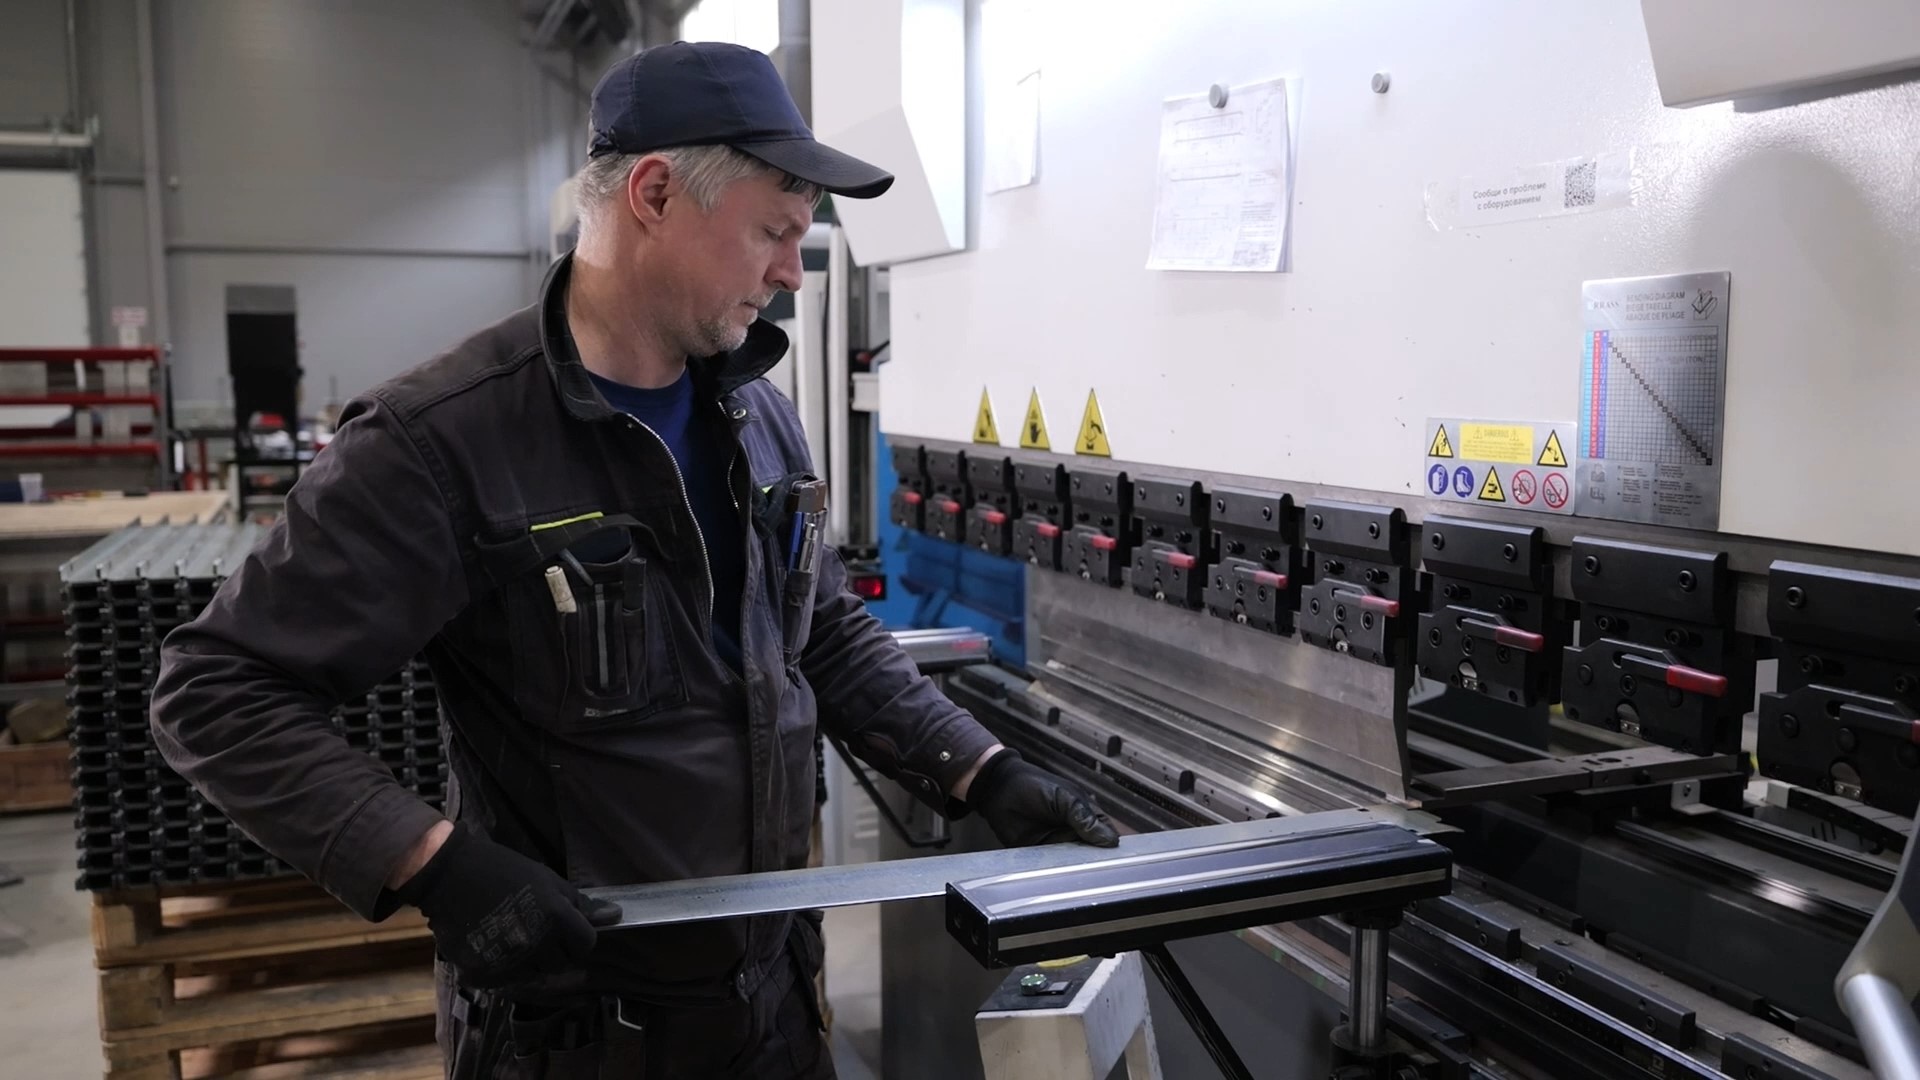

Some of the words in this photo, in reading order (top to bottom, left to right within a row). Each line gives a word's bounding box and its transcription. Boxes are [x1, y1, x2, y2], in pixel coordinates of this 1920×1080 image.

[1472, 188, 1501, 200] Сообщи
[1509, 182, 1547, 195] проблеме
[1483, 195, 1542, 210] оборудованием
